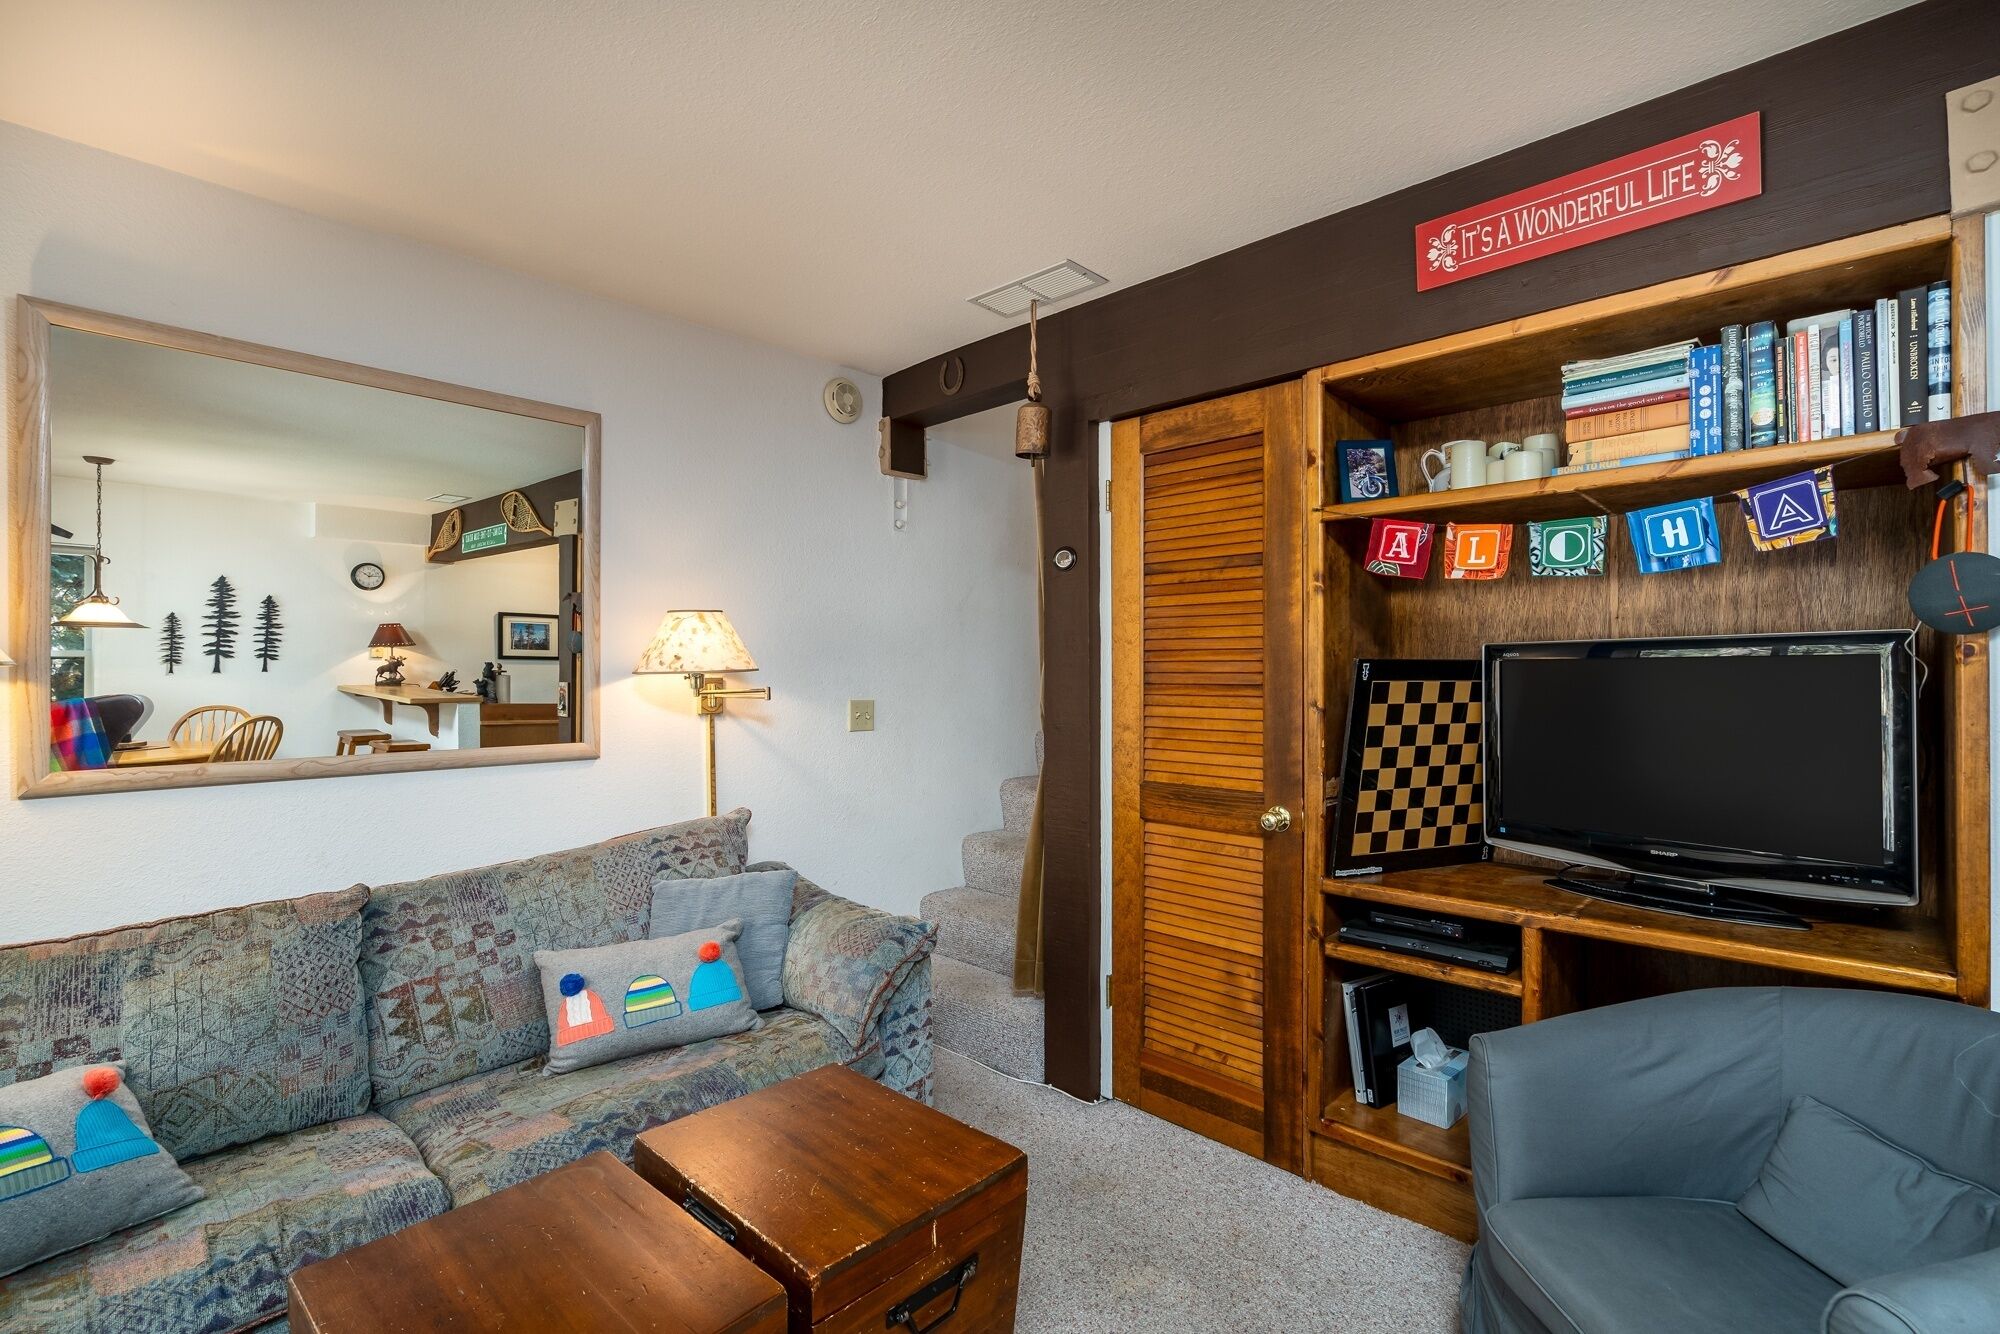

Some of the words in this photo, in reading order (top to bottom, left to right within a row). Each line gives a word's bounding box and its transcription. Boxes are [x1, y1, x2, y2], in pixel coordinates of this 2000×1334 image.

[1461, 226, 1492, 259] IT'S
[1497, 216, 1512, 249] A
[1515, 186, 1642, 242] WONDERFUL
[1647, 161, 1696, 202] LIFE
[1750, 369, 1773, 377] CANNOT
[1861, 351, 1872, 379] PAULO
[1909, 341, 1919, 380] UNBROKEN
[1861, 381, 1873, 418] COELHO
[1557, 464, 1584, 474] BORN
[1585, 463, 1597, 472] TO
[1598, 460, 1621, 469] RUN
[1385, 531, 1409, 558] A
[1467, 536, 1486, 564] L
[1549, 530, 1585, 563] O
[1661, 516, 1690, 547] H
[1770, 493, 1813, 530] A
[1650, 849, 1679, 857] SHARP
